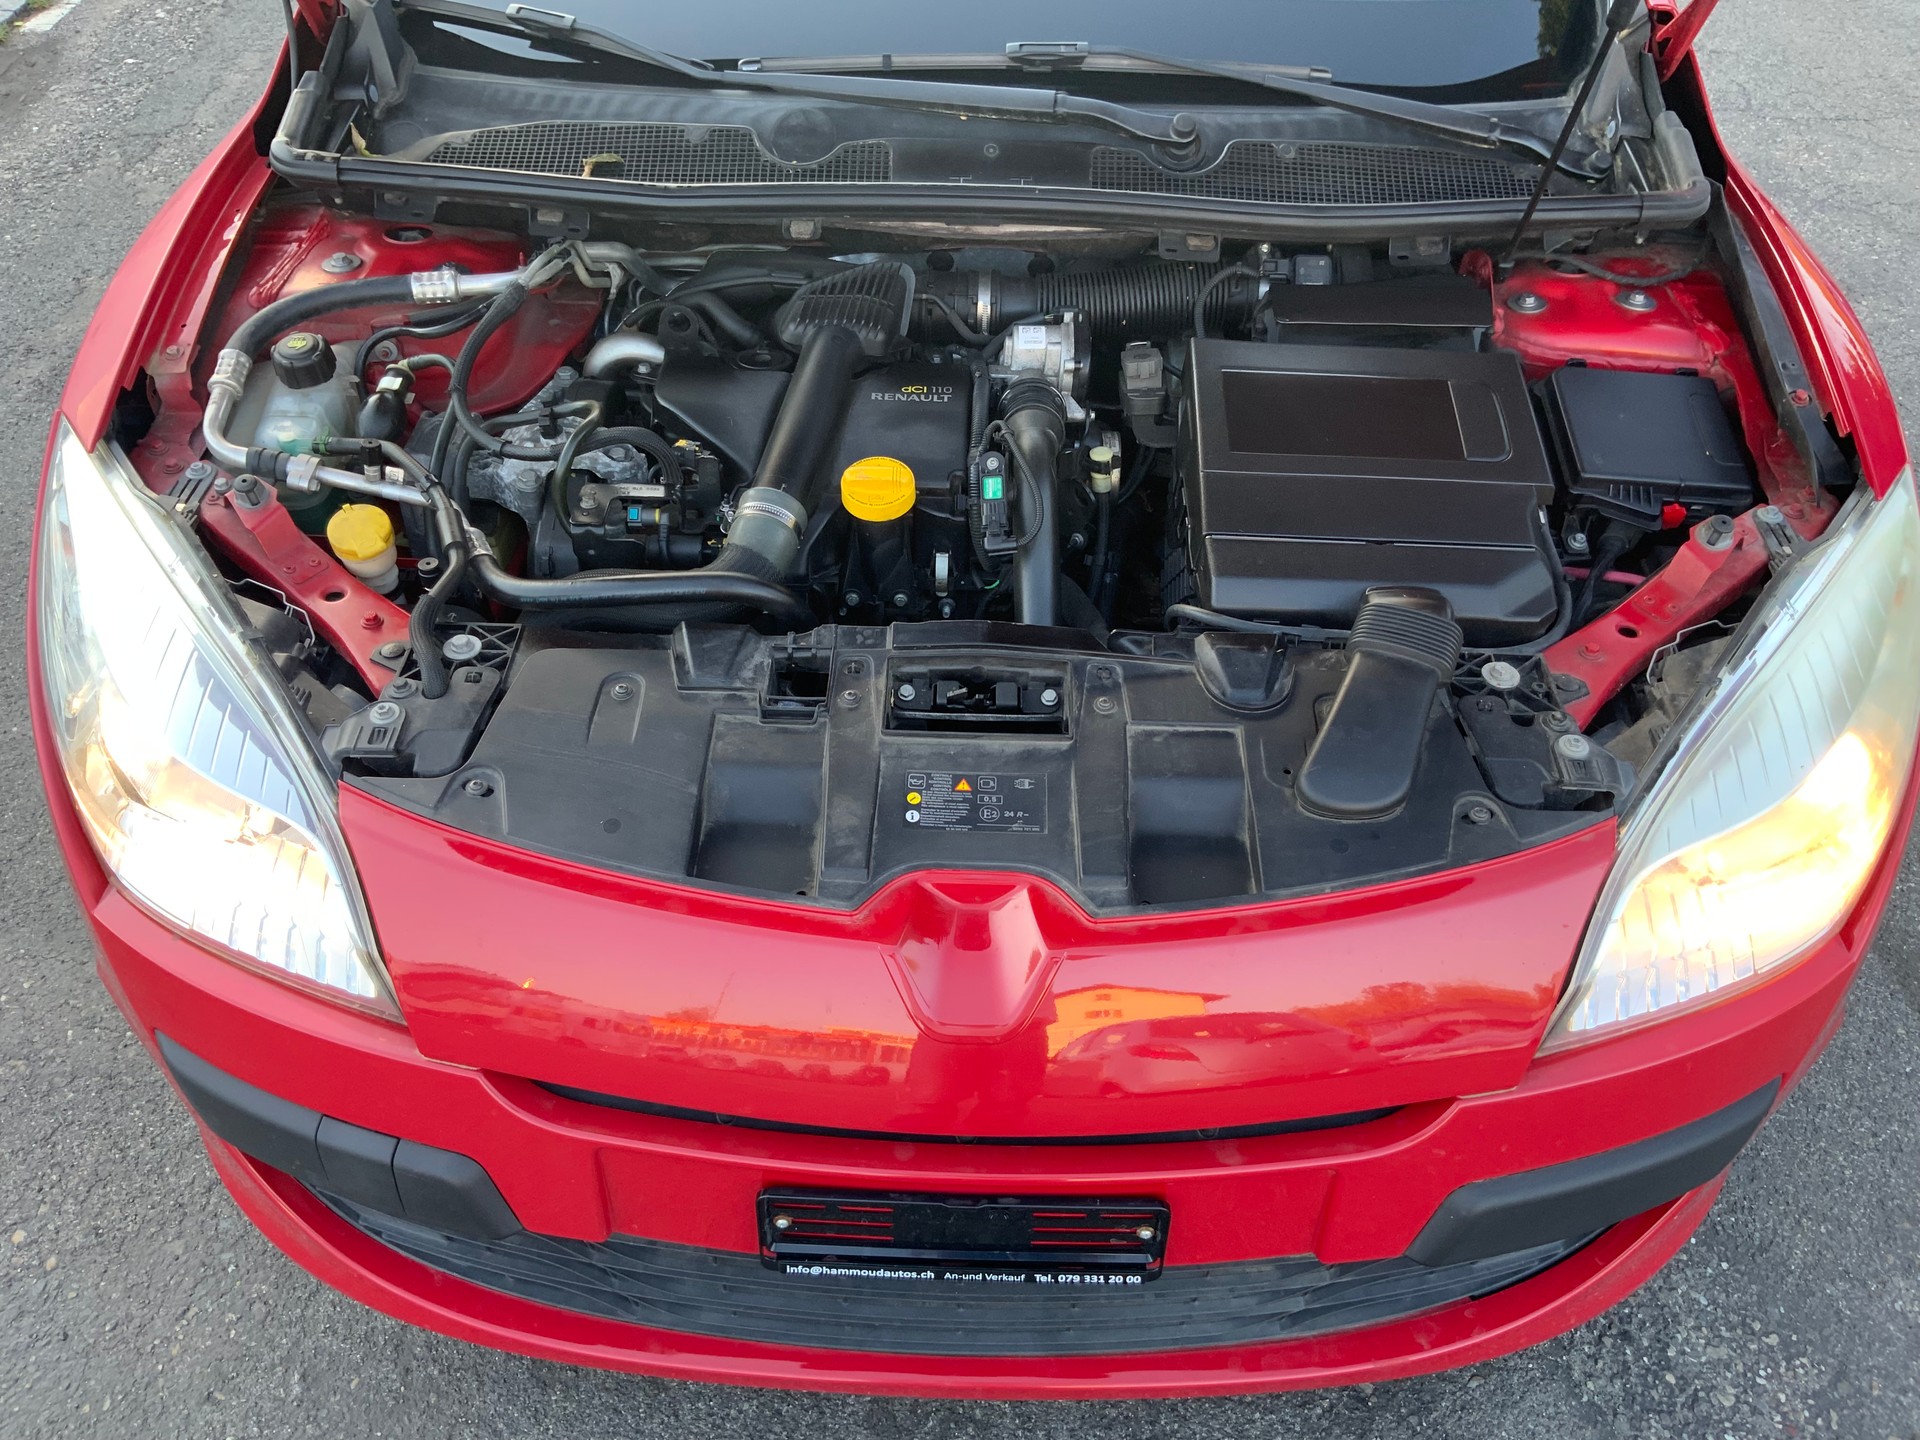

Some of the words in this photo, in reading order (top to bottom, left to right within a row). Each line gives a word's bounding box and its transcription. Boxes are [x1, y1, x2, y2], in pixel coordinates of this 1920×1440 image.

[931, 386, 953, 394] 110
[871, 392, 952, 402] RENAULT
[983, 809, 998, 819] E2
[786, 1265, 935, 1279] info@hammoudautos.ch
[944, 1272, 982, 1281] An-und
[985, 1273, 1025, 1282] Verkauf
[1034, 1274, 1054, 1283] Tel.
[1058, 1274, 1081, 1283] 079
[1084, 1275, 1104, 1283] 331
[1108, 1275, 1123, 1283] 20
[1126, 1275, 1142, 1284] 00
